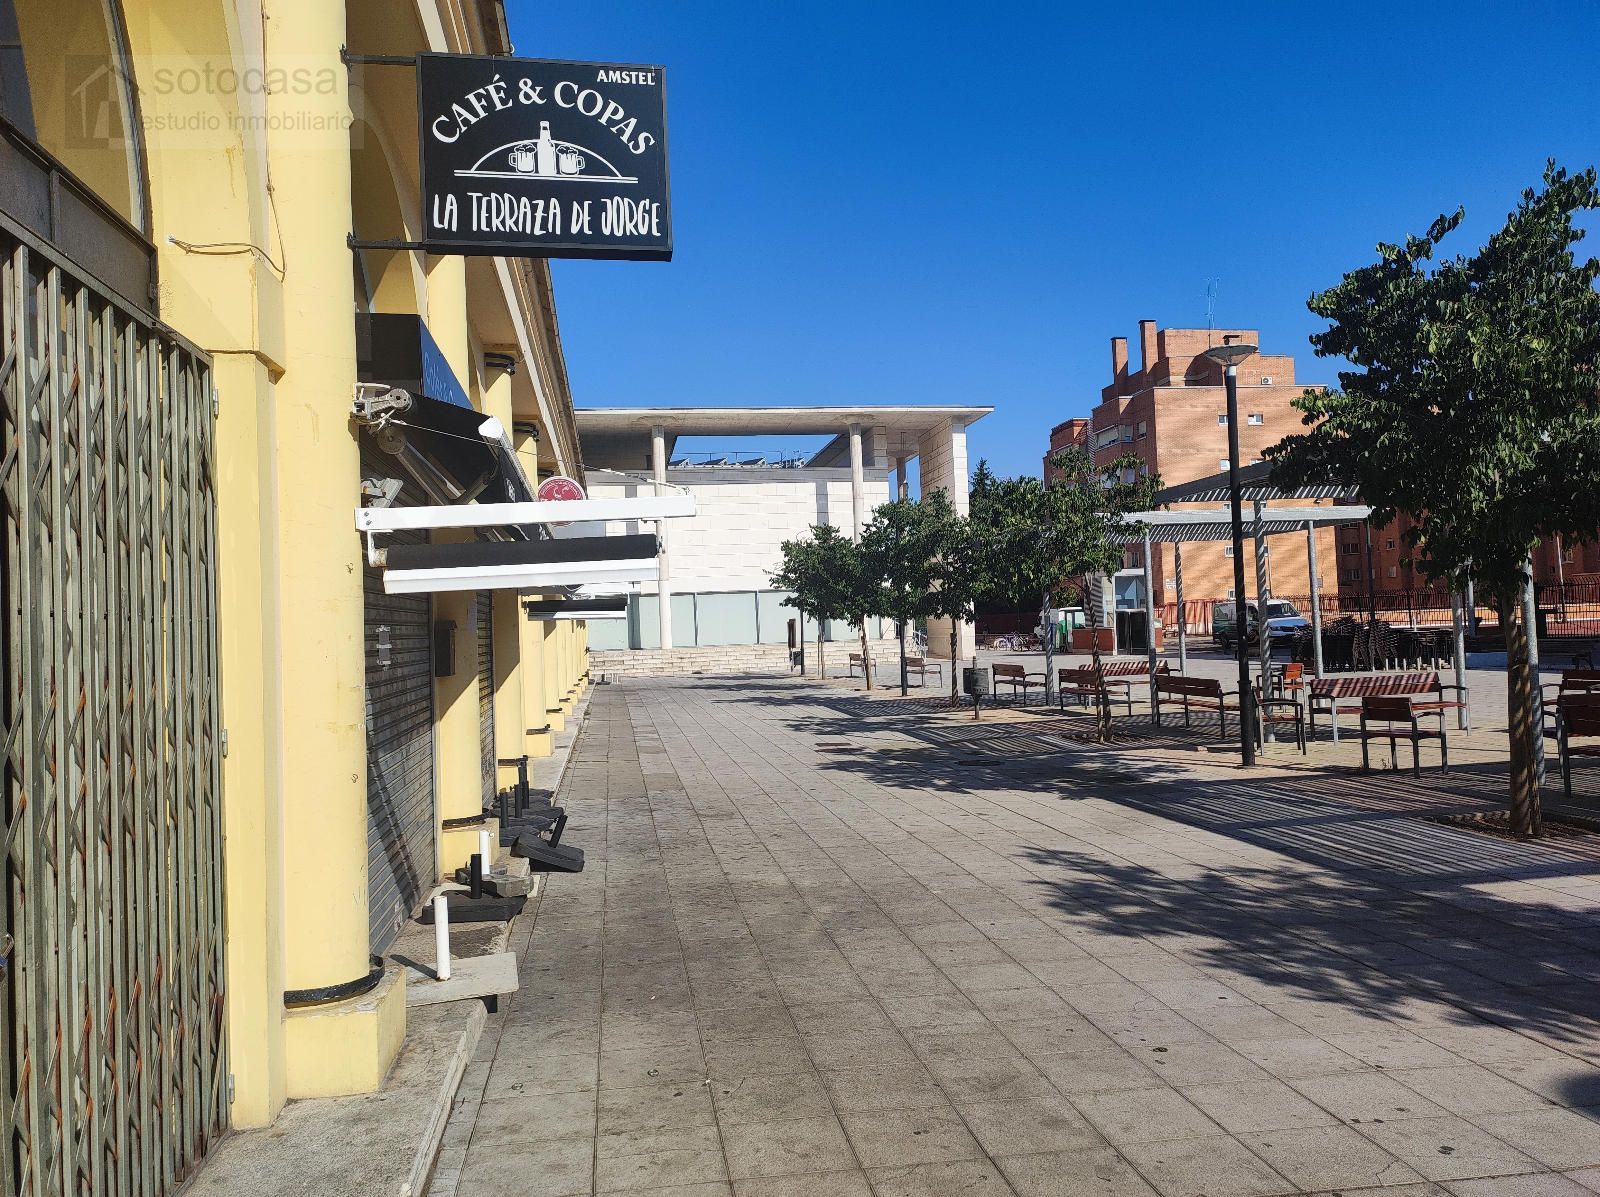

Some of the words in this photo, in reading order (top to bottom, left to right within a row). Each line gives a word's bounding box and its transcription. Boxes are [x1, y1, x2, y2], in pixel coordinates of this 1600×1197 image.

[596, 69, 656, 86] AMSTEL
[432, 74, 513, 143] CAFÉ
[518, 78, 547, 105] &
[554, 81, 656, 155] COPAS
[432, 193, 458, 232] LA
[467, 192, 561, 236] TERRAZA
[570, 200, 593, 235] DE
[601, 195, 661, 237] JORGE
